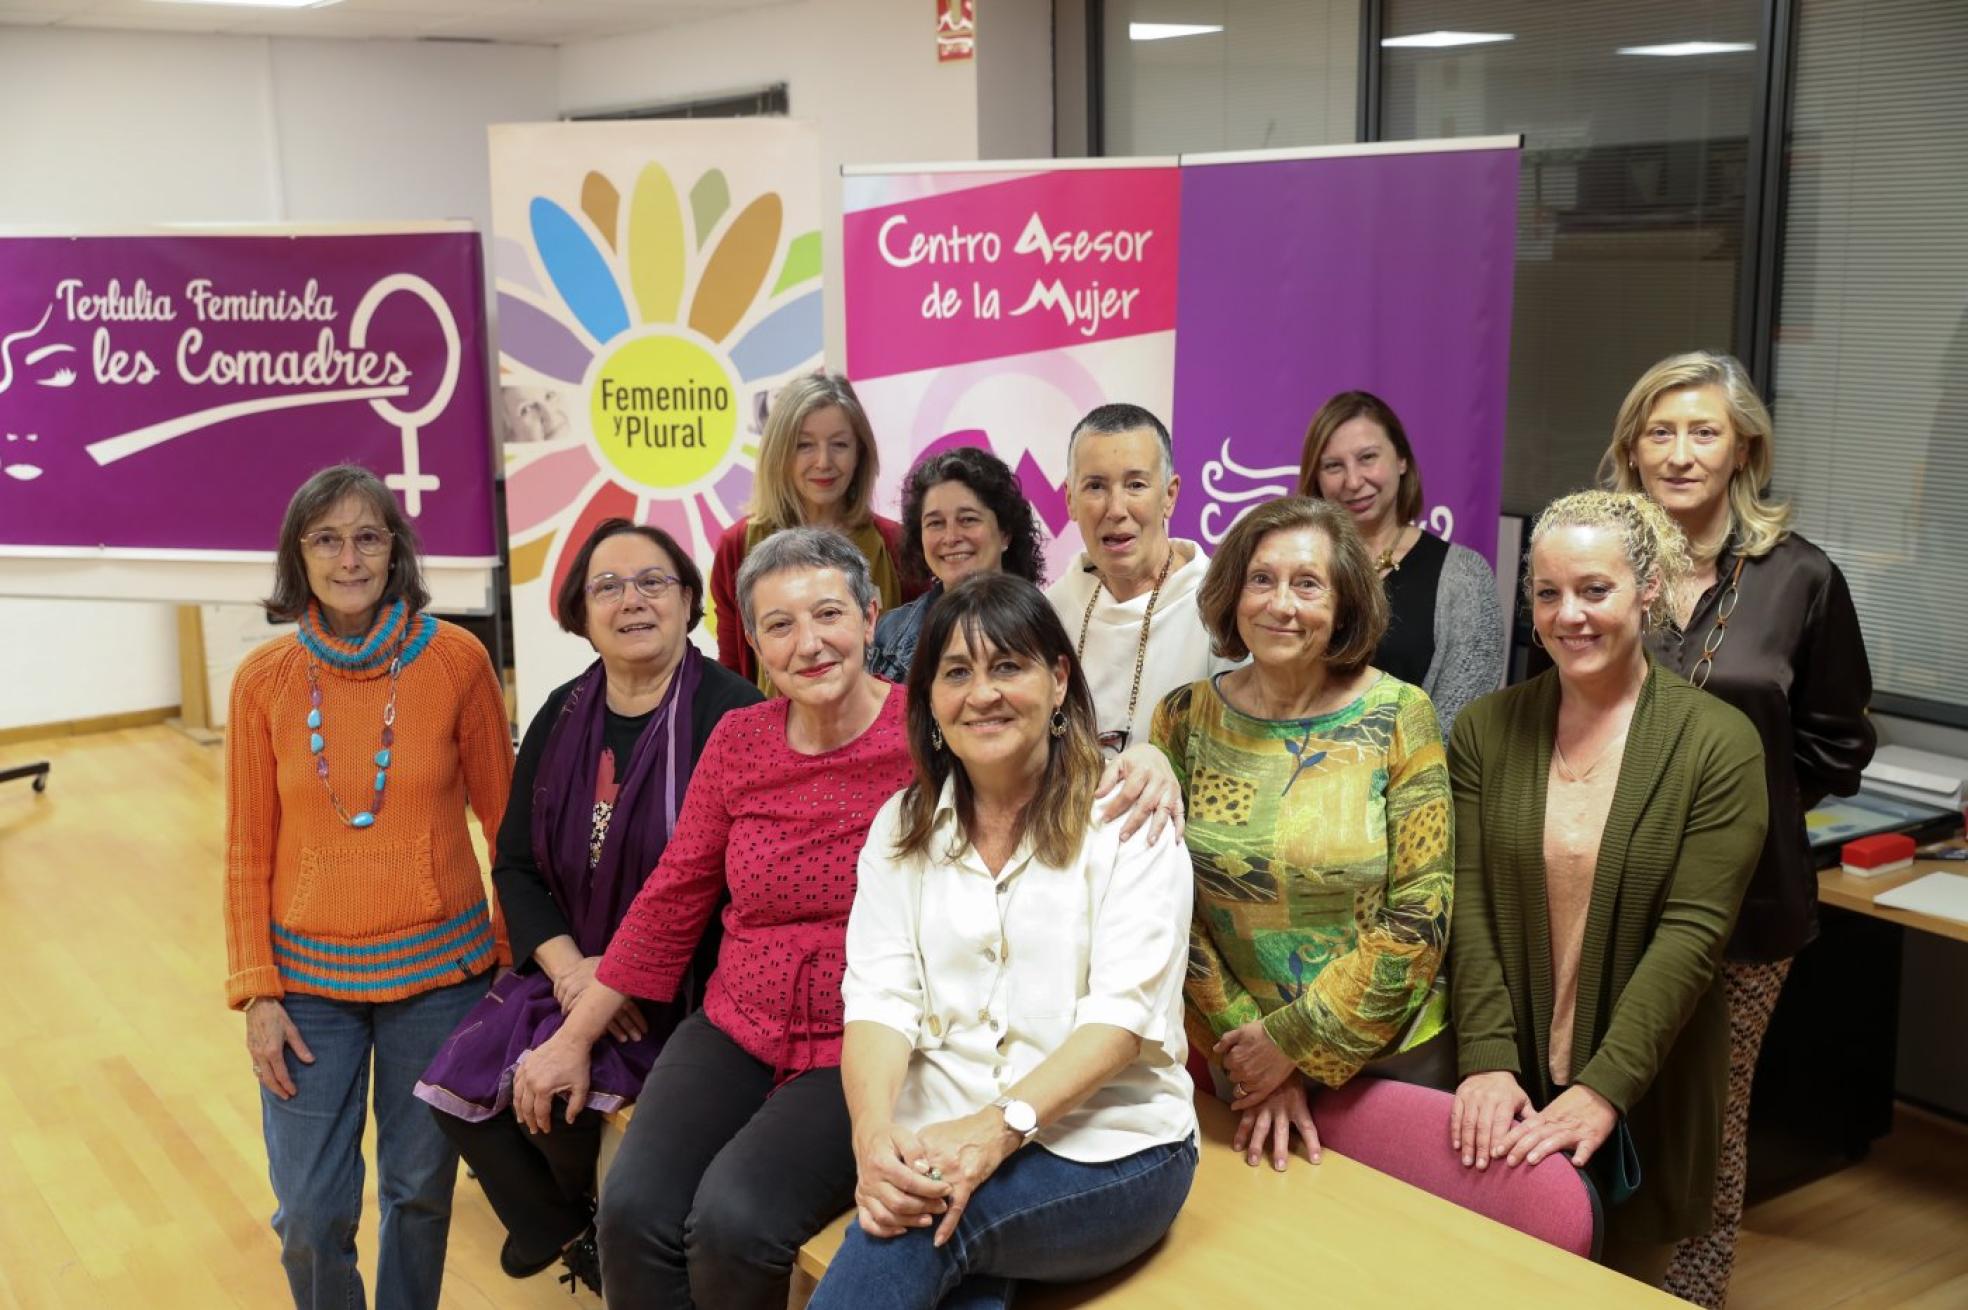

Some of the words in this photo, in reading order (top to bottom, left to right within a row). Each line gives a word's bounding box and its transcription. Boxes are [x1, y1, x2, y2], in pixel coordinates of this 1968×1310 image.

[878, 214, 1001, 267] Centro
[1013, 212, 1153, 264] Asesor
[921, 281, 962, 319] de
[973, 281, 1001, 320] la
[1008, 279, 1140, 337] Mujer
[93, 327, 159, 384] les
[176, 327, 412, 386] Comadres
[601, 378, 729, 411] Femenino
[613, 416, 623, 436] y
[626, 415, 707, 449] Plural
